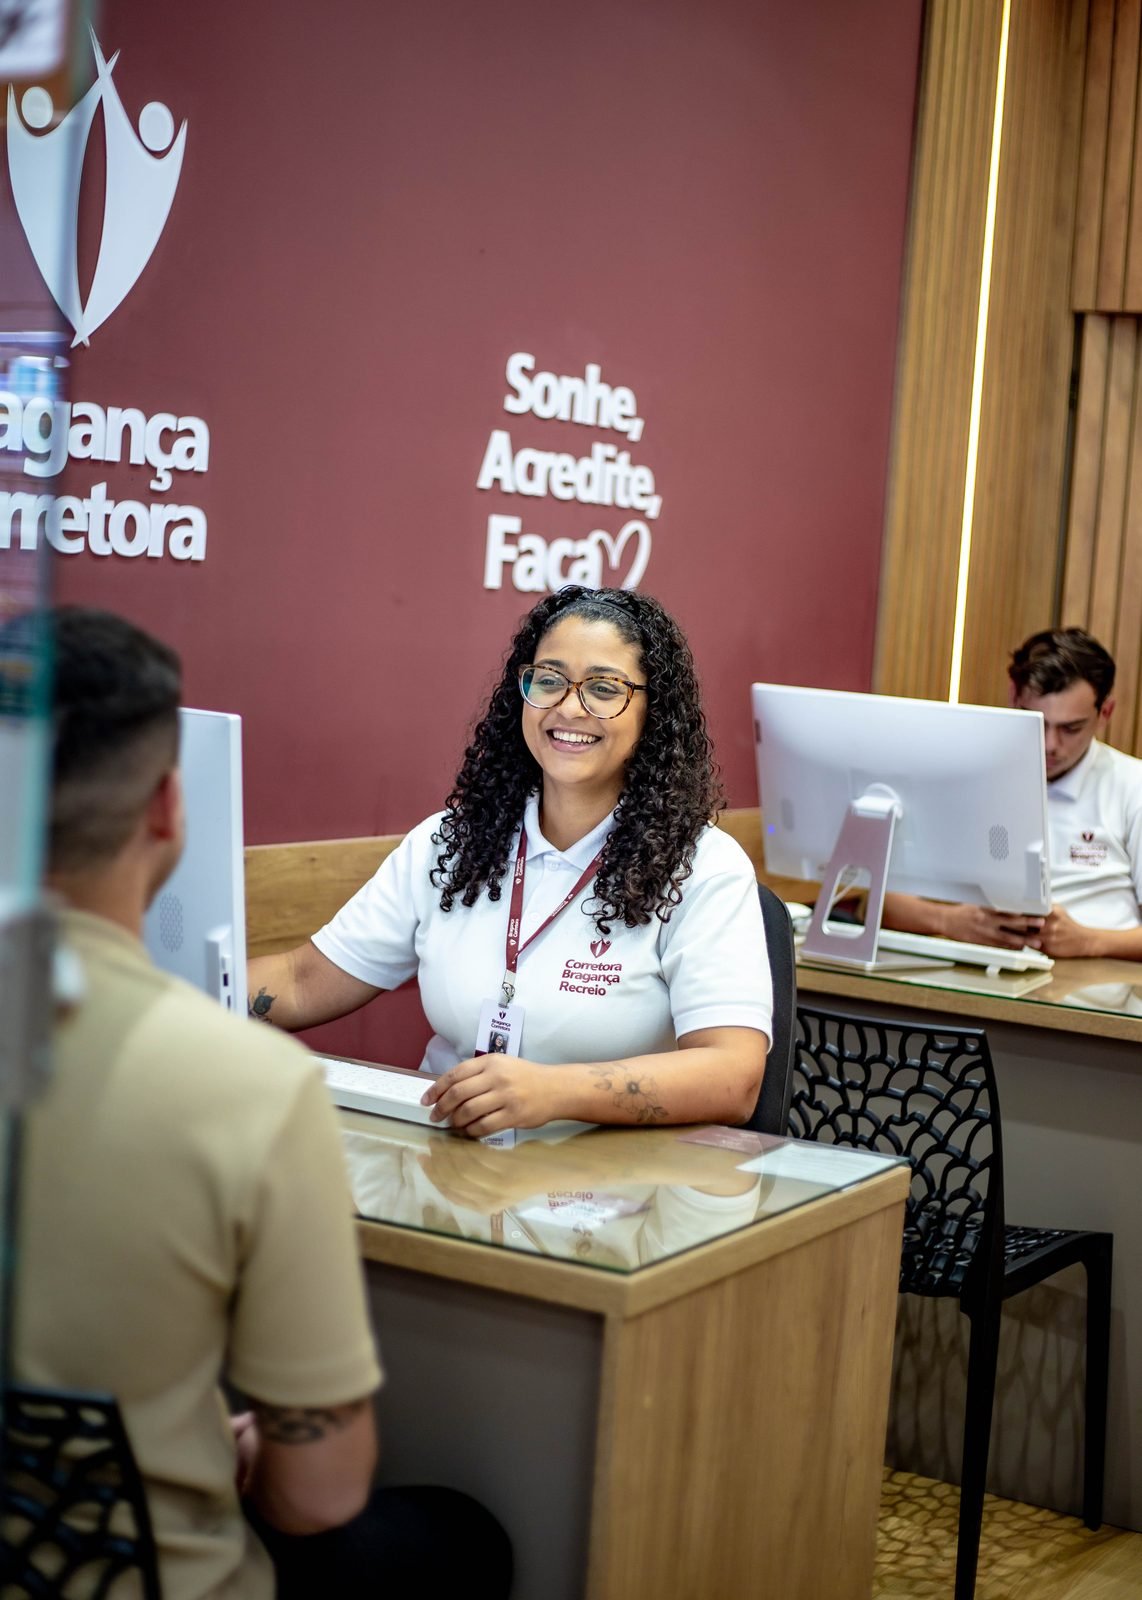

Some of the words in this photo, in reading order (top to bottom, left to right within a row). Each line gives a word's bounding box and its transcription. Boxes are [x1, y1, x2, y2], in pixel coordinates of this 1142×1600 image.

[504, 351, 645, 442] Sonhe,
[476, 429, 663, 519] Acredite,
[565, 959, 622, 971] Corretora
[561, 969, 620, 985] Bragança
[559, 981, 606, 996] Recreio
